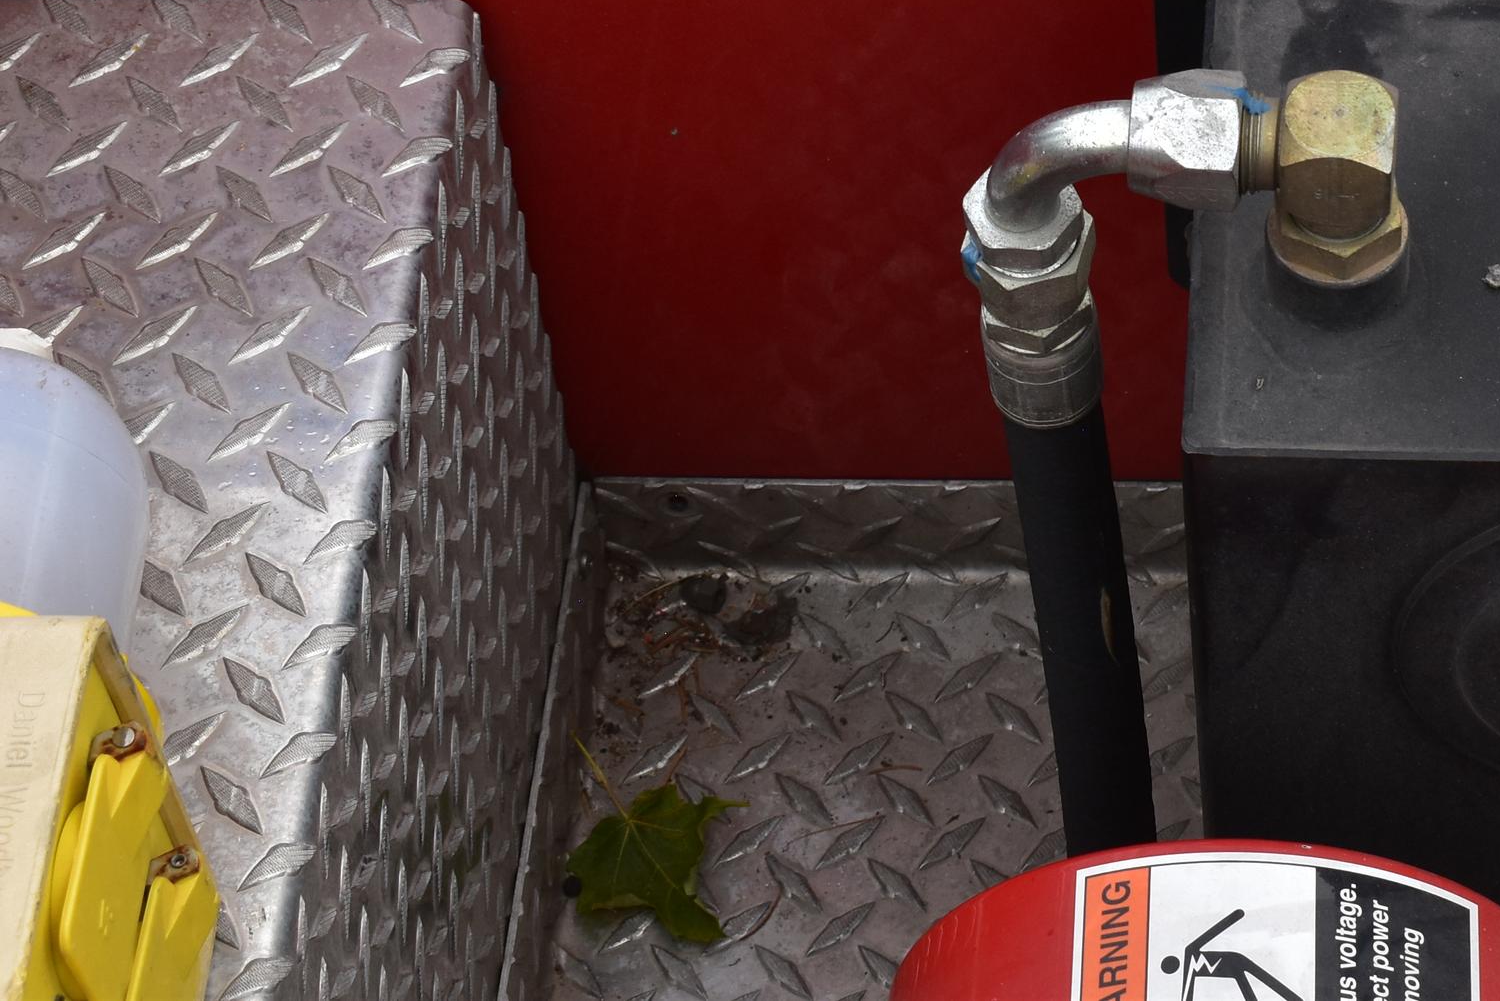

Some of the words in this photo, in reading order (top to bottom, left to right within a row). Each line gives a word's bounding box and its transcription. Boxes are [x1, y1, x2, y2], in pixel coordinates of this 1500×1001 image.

[5, 690, 46, 769] Daniel
[1334, 883, 1363, 969] voltage.
[1372, 899, 1395, 972] power
